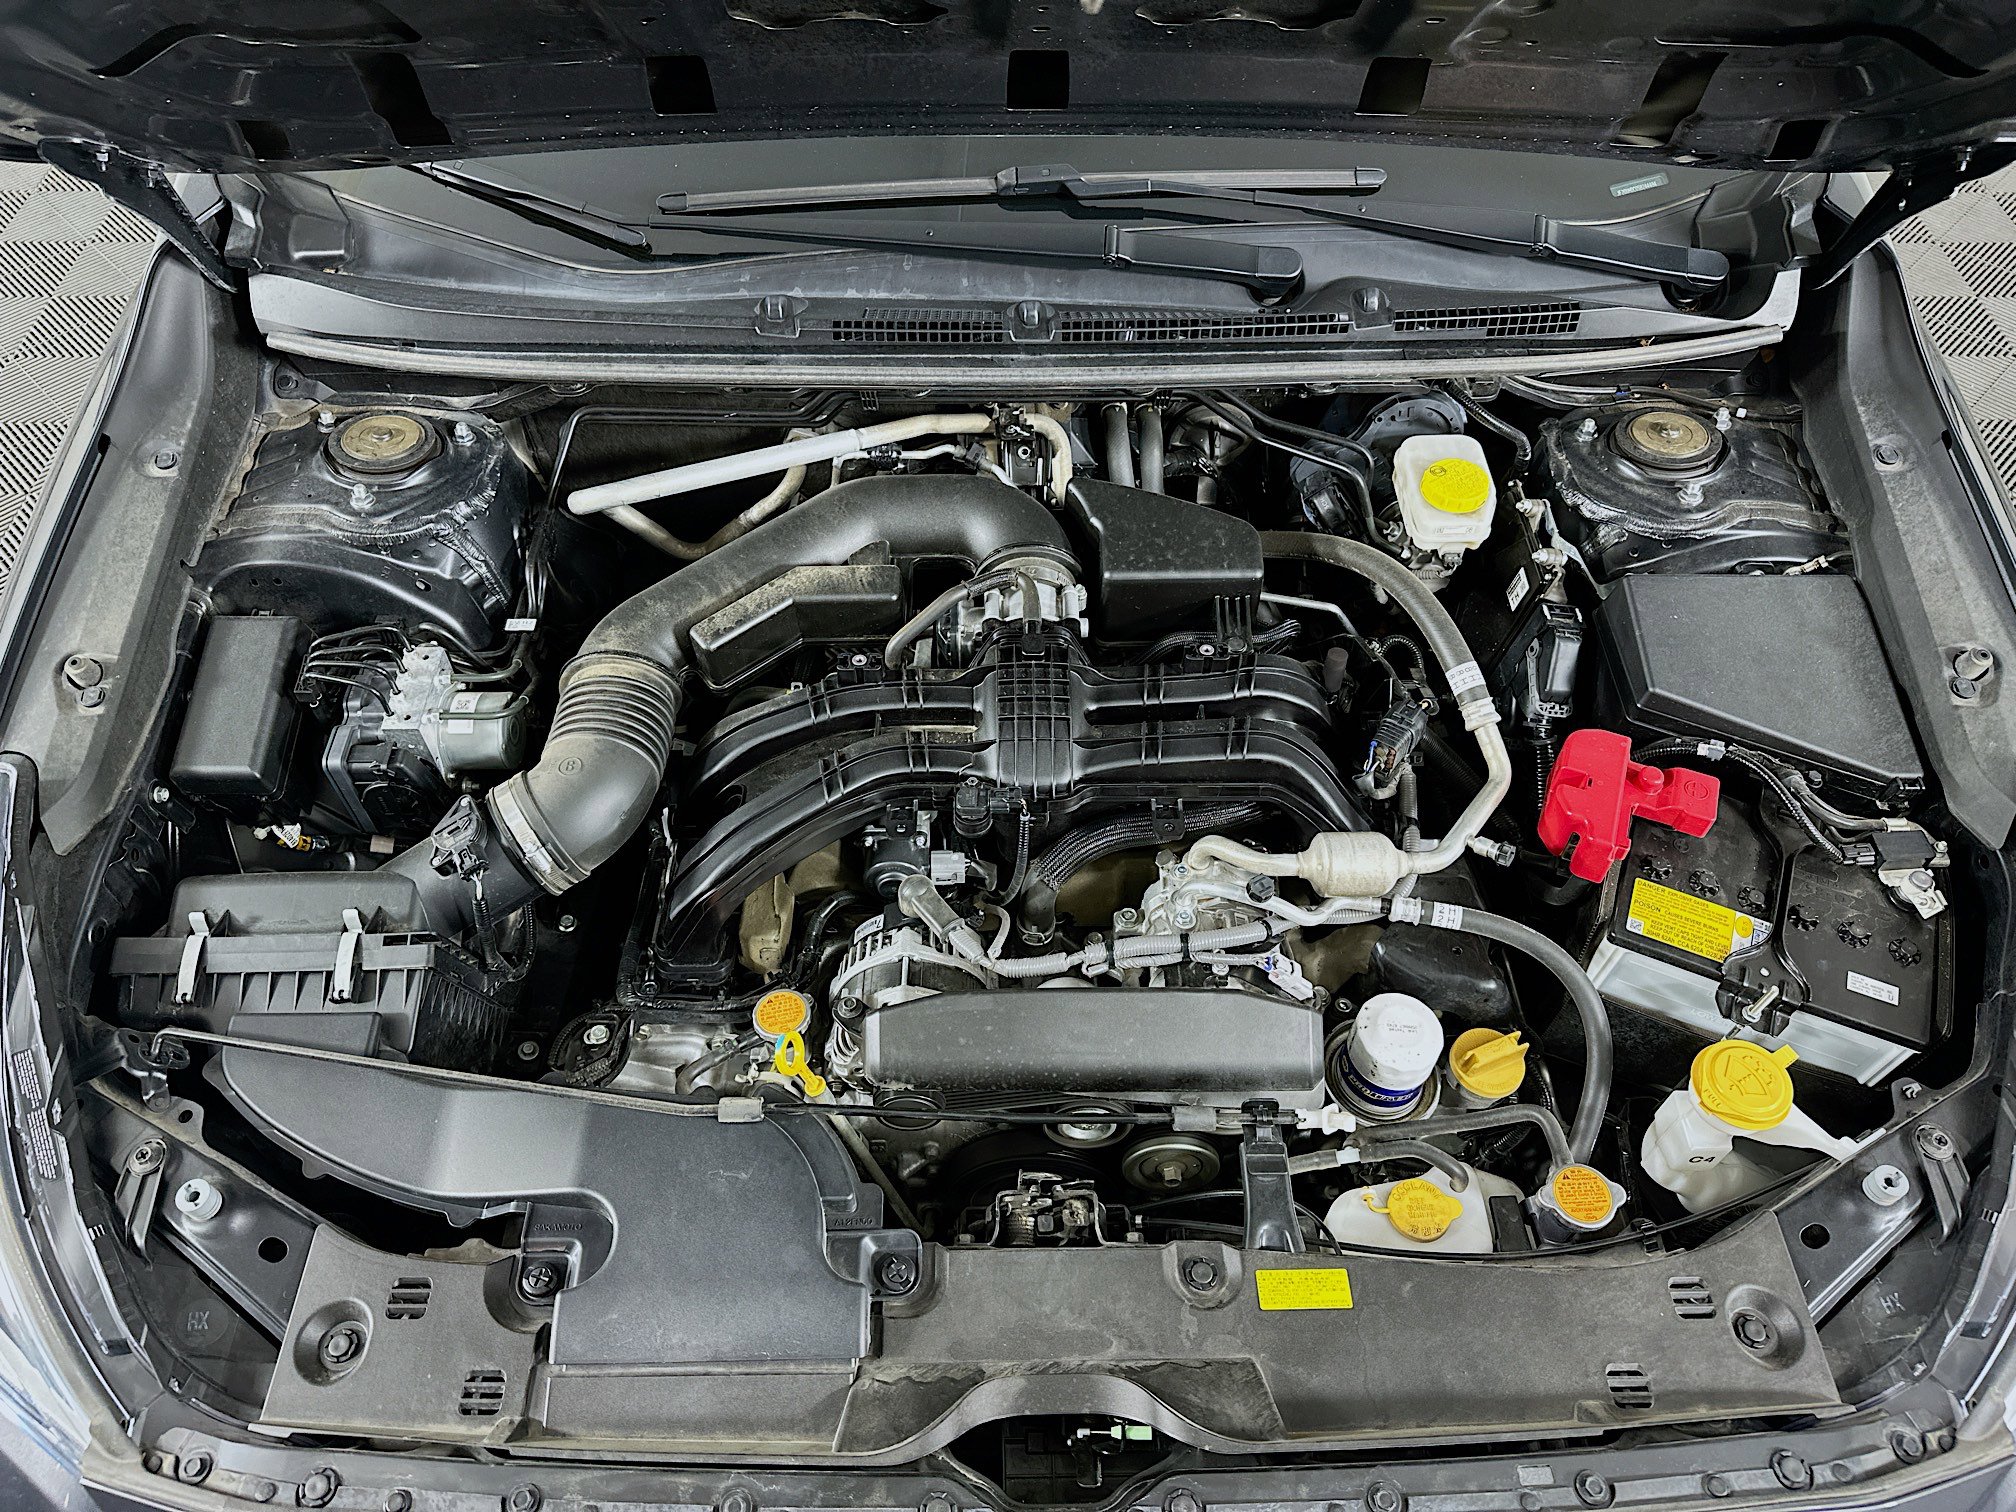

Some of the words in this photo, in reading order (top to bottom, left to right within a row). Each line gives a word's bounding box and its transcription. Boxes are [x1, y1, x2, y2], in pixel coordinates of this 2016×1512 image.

[1637, 880, 1666, 894] DANGER
[1667, 892, 1693, 905] EXPLOSIVE
[1693, 899, 1709, 909] GASES
[1633, 899, 1661, 913] POISON
[1664, 910, 1684, 921] CAUSES
[1684, 916, 1703, 927] SEVERE
[1702, 922, 1719, 932] BURNS
[1677, 927, 1690, 936] CAPS
[1704, 938, 1715, 946] AND
[1677, 939, 1690, 948] CCA
[1689, 1156, 1716, 1164] C4
[1392, 1180, 1443, 1202] COOLANT
[187, 1310, 210, 1331] HX
